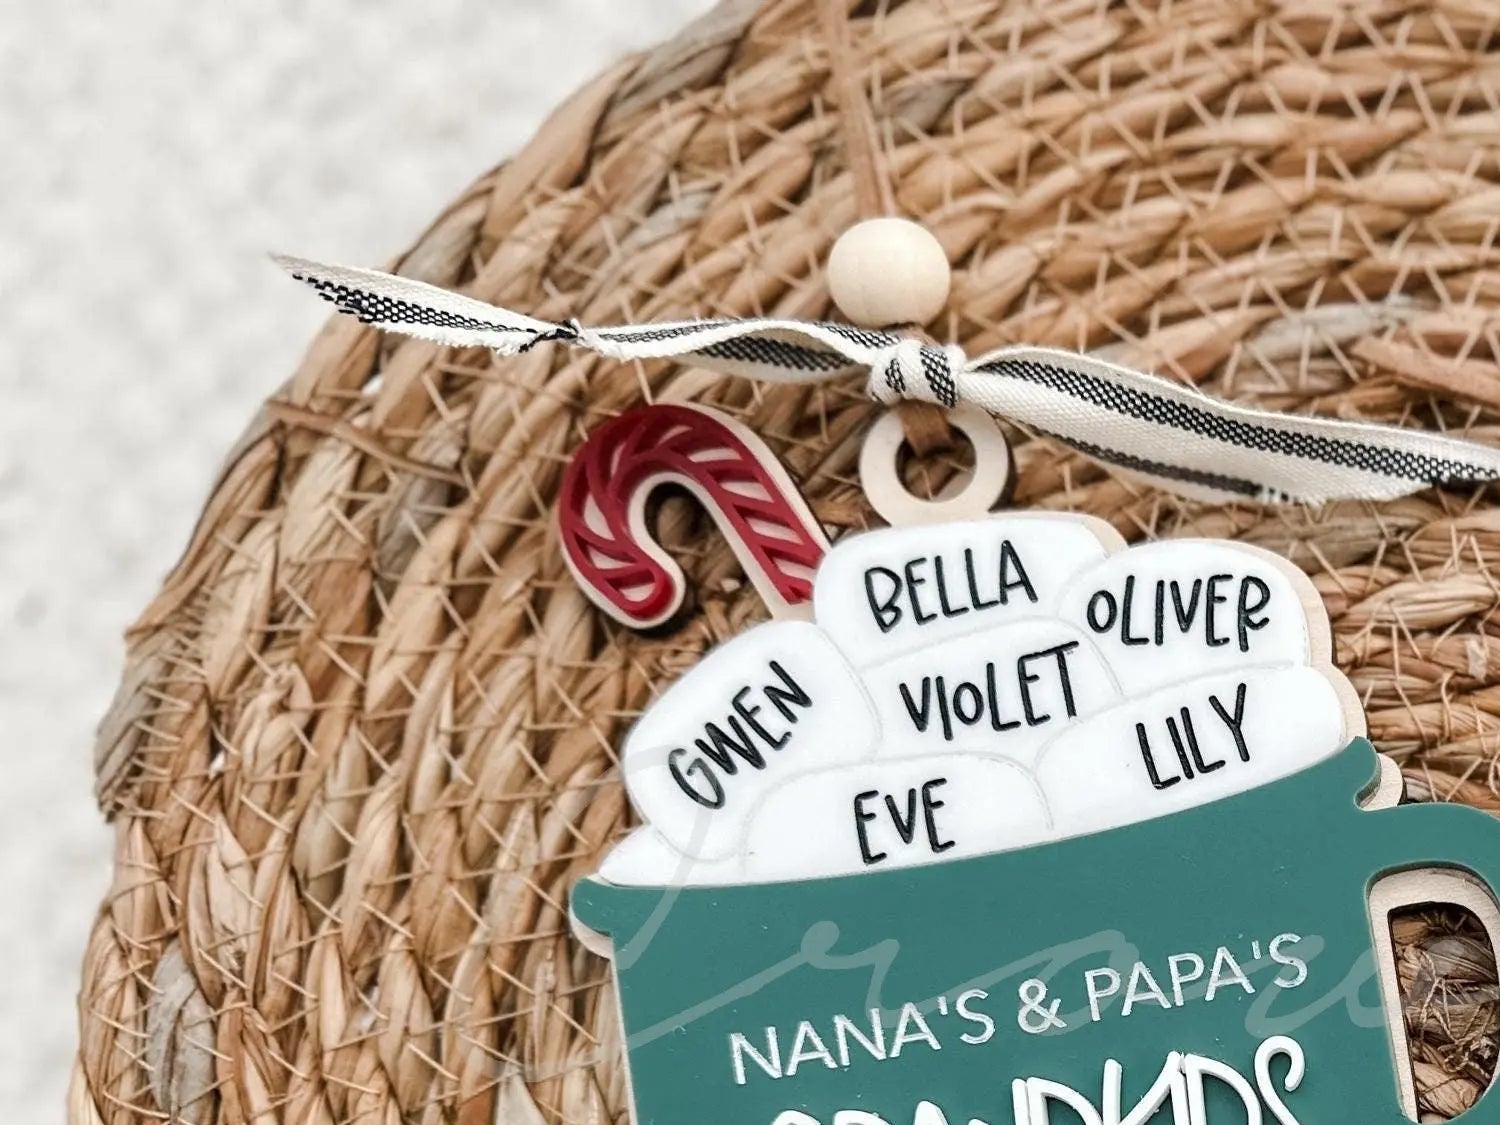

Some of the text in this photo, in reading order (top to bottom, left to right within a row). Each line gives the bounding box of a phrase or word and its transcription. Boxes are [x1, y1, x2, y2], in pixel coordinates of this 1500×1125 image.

[864, 539, 1039, 634] BELLA
[1086, 573, 1272, 653] OLIVER
[667, 659, 813, 810] GWEN
[898, 640, 1081, 741] VIOLET
[1135, 682, 1252, 790] LILY
[853, 776, 957, 865] EVE
[729, 932, 1309, 1085] NANA'S & PAPA'S
